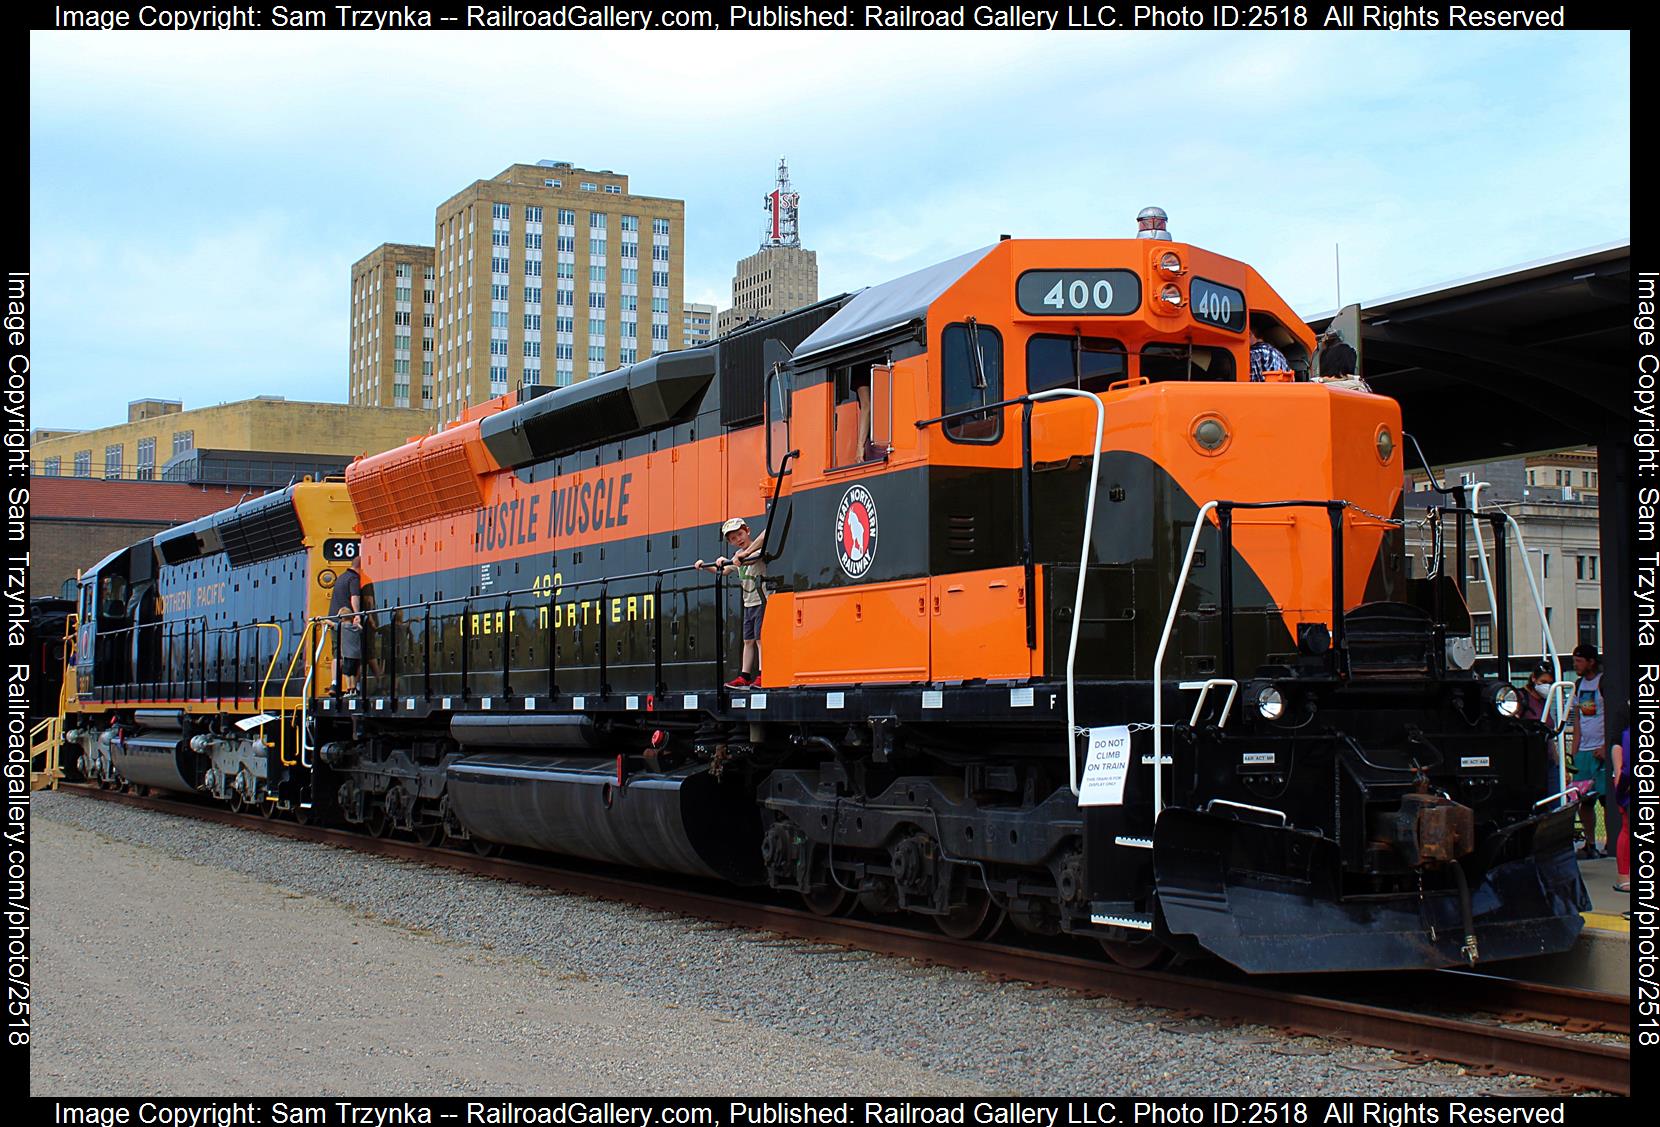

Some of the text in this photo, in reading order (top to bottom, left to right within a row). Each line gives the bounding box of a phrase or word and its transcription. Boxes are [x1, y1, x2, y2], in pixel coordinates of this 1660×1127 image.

[768, 188, 799, 239] 1st
[1043, 279, 1113, 309] 400
[1199, 290, 1231, 324] 400
[475, 473, 632, 552] HUSTLE MUSCLE
[838, 488, 876, 542] GREAT NORTHERN
[842, 549, 871, 574] RAILWAY
[155, 581, 226, 616] NORTHERN PACIFIC
[532, 572, 563, 598] 400
[1050, 694, 1057, 710] F
[1094, 738, 1125, 749] DO NOT
[1096, 750, 1121, 760] CLIMB
[1087, 762, 1126, 772] ON TRAIN
